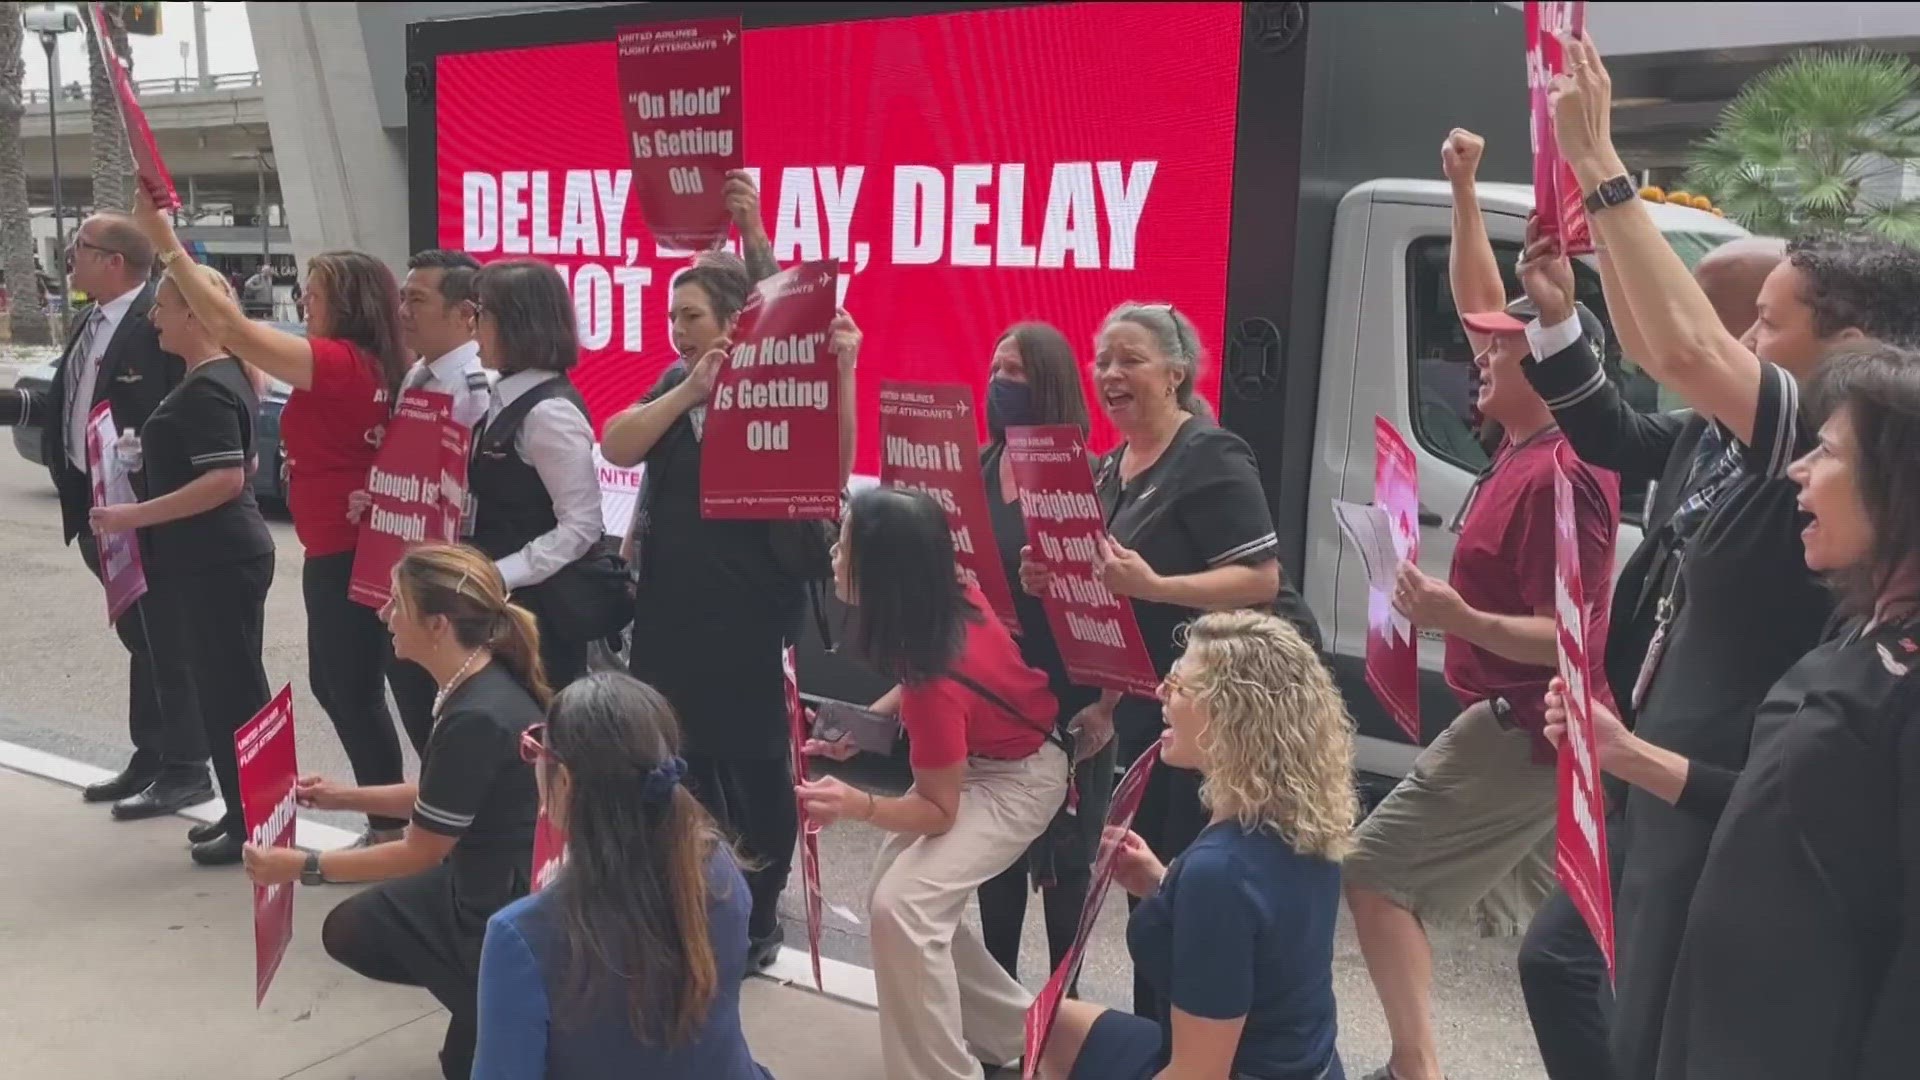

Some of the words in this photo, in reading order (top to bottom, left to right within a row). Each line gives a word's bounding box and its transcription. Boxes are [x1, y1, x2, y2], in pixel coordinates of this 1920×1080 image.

[619, 45, 651, 56] FLIGHT
[653, 39, 718, 54] ATTENDANTS
[655, 27, 698, 40] AIRLINES
[628, 91, 666, 120] “On
[669, 85, 731, 117] Hold”
[632, 131, 653, 159] Is
[654, 127, 733, 157] Getting
[669, 166, 704, 195] Old
[463, 169, 639, 267] DELAY,
[892, 161, 1158, 270] DELAY
[555, 263, 652, 353] OT
[759, 332, 826, 366] Hold”
[713, 382, 734, 410] Is
[737, 376, 829, 410] Getting
[899, 407, 953, 419] ATTENDANTS
[746, 420, 789, 451] Old
[886, 434, 941, 471] When
[943, 440, 963, 472] it
[368, 465, 420, 503] Enough
[370, 503, 426, 542] Enough!
[1019, 487, 1101, 524] Straighten
[1038, 530, 1063, 564] Up
[1065, 611, 1127, 649] United!
